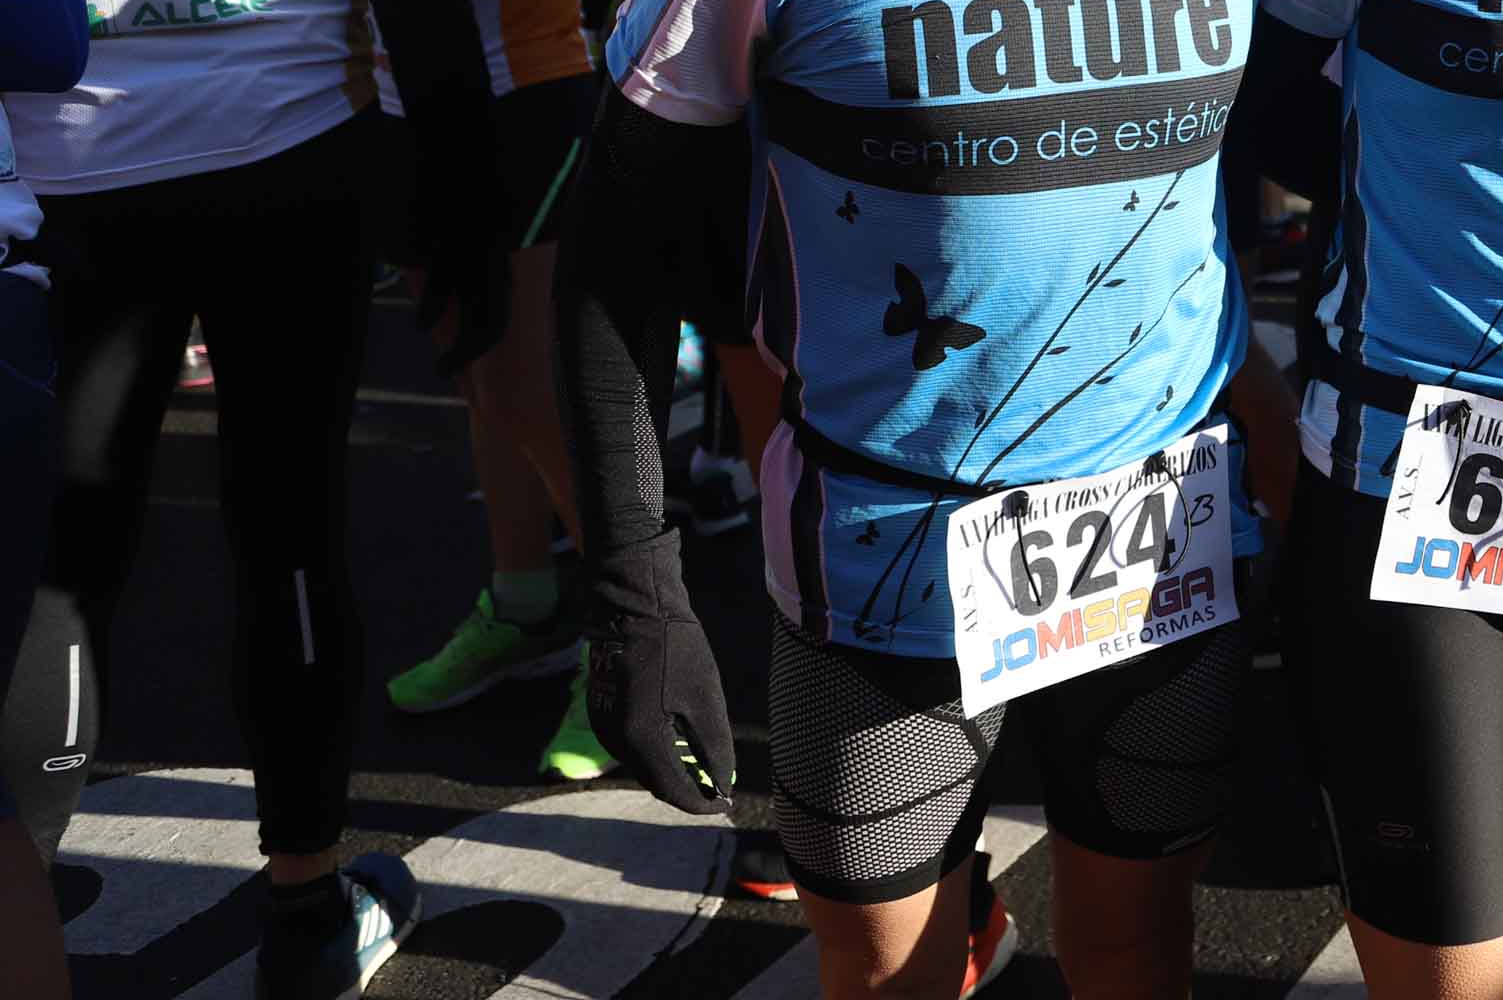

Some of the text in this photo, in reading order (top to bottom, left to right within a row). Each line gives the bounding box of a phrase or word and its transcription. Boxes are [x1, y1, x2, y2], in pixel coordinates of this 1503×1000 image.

[863, 130, 1018, 168] centro
[1036, 118, 1098, 160] de
[1055, 481, 1114, 513] CROSS
[1009, 492, 1176, 617] 624
[980, 565, 1216, 683] JOMISAGA
[1098, 605, 1217, 657] REFORMAS
